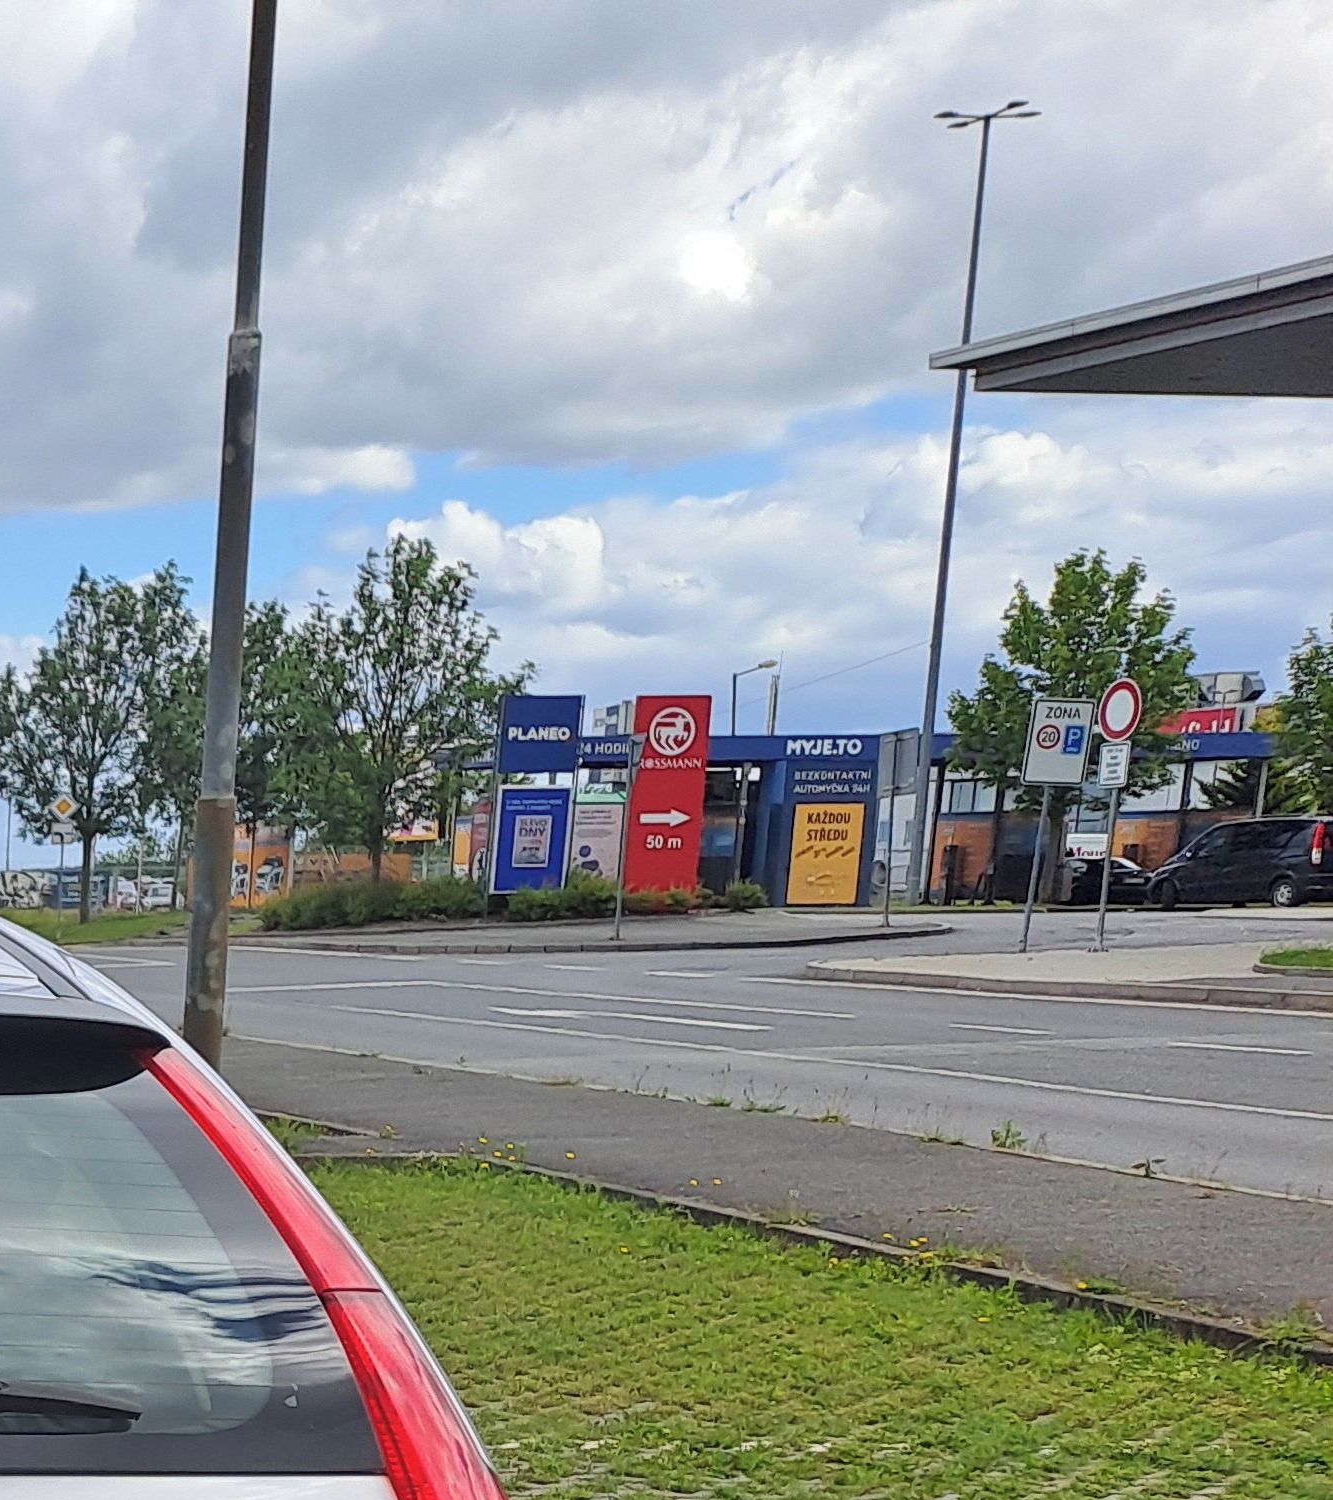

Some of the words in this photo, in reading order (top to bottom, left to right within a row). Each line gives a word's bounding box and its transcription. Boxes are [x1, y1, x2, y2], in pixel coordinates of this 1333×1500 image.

[1045, 706, 1081, 719] ZONA
[508, 726, 571, 741] PLANEO
[1041, 731, 1056, 743] 20
[1068, 728, 1081, 745] P
[786, 739, 862, 756] MYJE.TO
[639, 758, 702, 769] ROSSMANN
[807, 810, 851, 824] KAŽDOU
[519, 827, 546, 837] DNY
[806, 827, 849, 842] STŘEDU
[645, 835, 663, 849] 50
[667, 838, 682, 849] m
